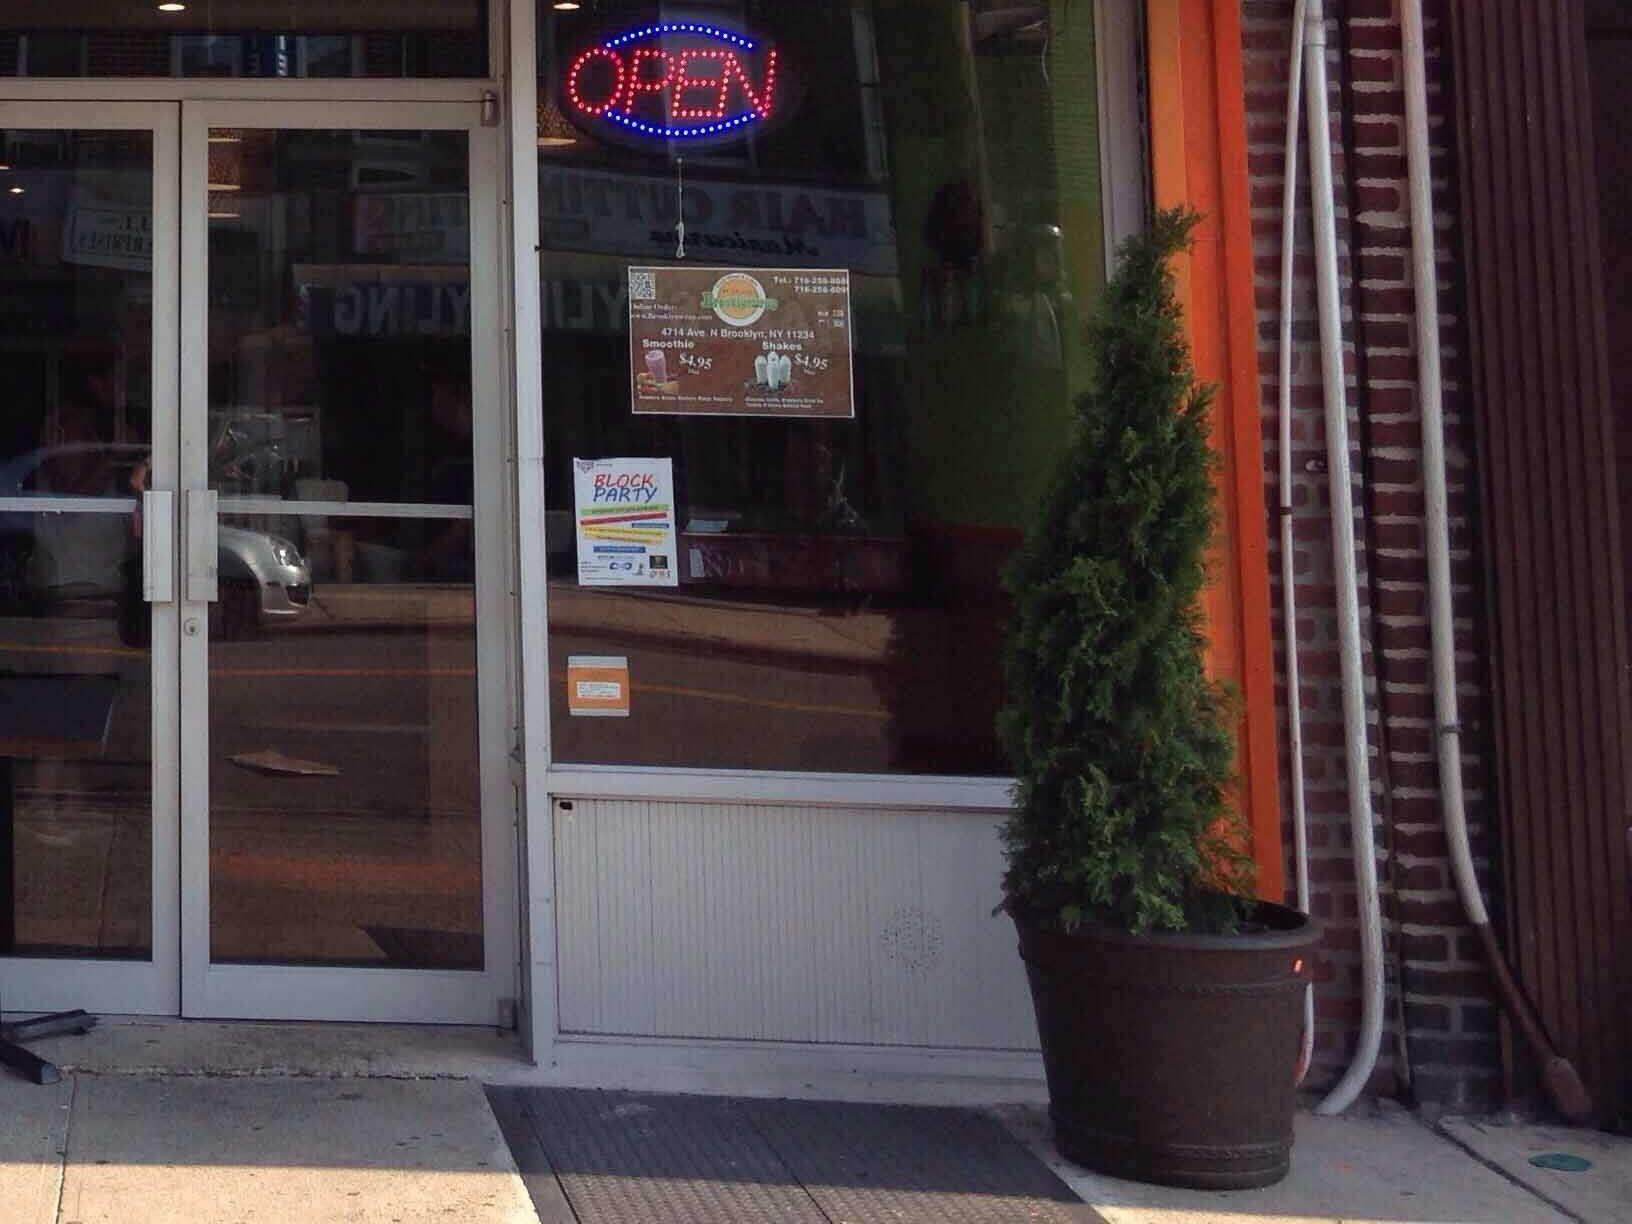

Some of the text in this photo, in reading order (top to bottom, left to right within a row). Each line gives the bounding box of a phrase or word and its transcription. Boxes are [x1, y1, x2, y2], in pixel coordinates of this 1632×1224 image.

[566, 48, 778, 118] OPEN
[661, 328, 685, 337] 4714
[770, 329, 785, 339] NY
[642, 338, 802, 350] Smoothie Shakes
[594, 473, 653, 488] BLOCK
[593, 486, 658, 503] PARTY
